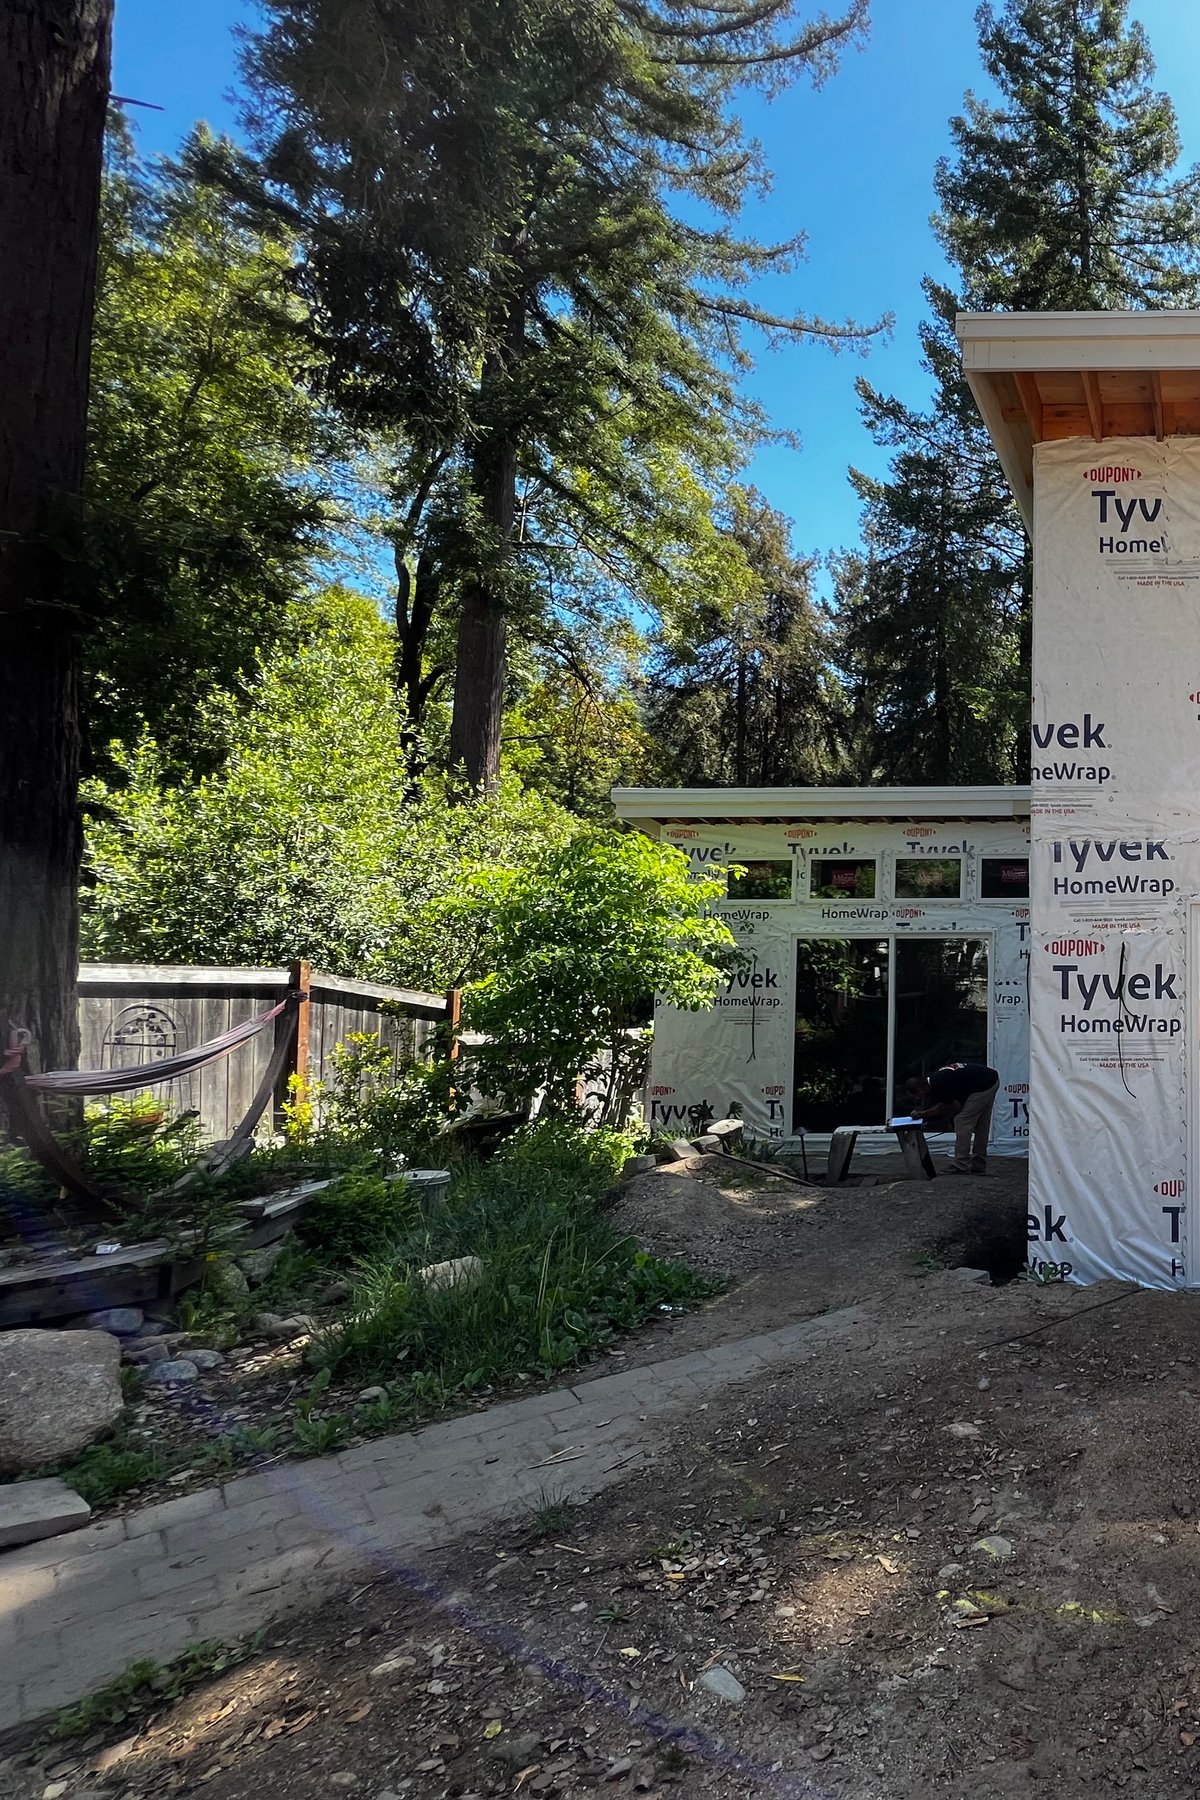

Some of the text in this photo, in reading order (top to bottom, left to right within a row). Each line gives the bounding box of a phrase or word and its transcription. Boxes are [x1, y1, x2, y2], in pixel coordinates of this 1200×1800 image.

[1090, 466, 1136, 483] DUPONT
[1054, 875, 1174, 897] HomeWrap
[703, 909, 769, 921] HomeWrap
[821, 908, 888, 920] HomeWrap
[896, 909, 921, 919] DUPONT
[1052, 939, 1099, 956] DUPONT
[715, 968, 779, 994] yvek
[1053, 963, 1177, 1010] Tyvek
[714, 995, 780, 1008] HomeWrap
[1061, 1015, 1181, 1037] HomeWrap
